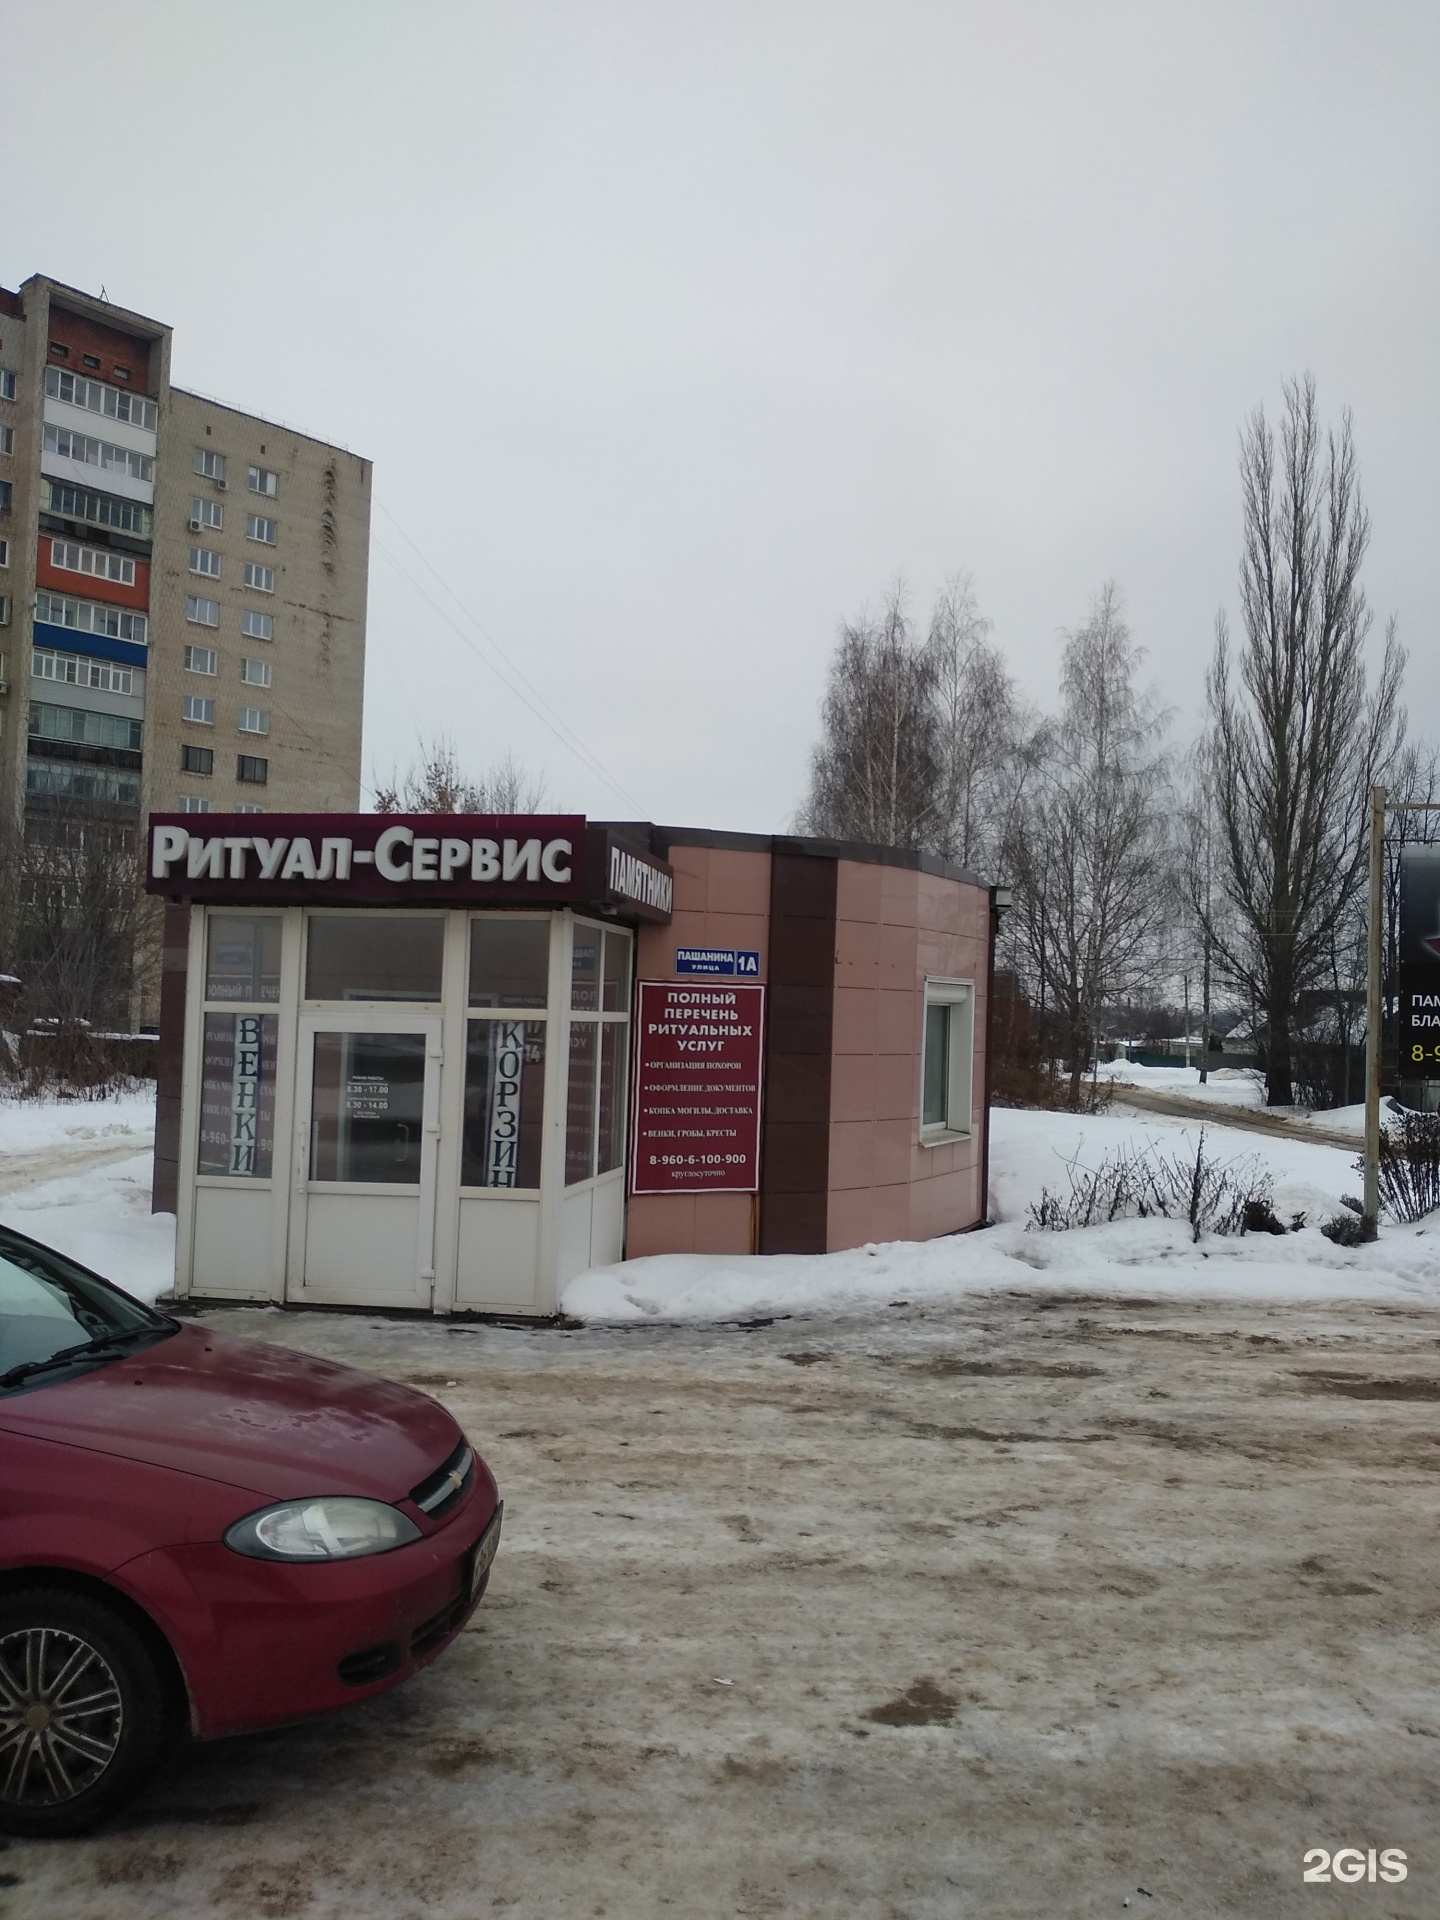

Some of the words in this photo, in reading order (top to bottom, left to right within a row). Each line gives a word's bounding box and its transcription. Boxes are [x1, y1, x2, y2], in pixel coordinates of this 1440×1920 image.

[152, 825, 573, 883] РИТУАЛ-СЕРВИС
[609, 846, 673, 914] ПАМЯТНИКИ
[677, 951, 734, 963] ПАШАНИНА
[738, 956, 757, 971] 1А
[667, 992, 736, 1005] ПОЛНЫЙ
[664, 1008, 739, 1020] ПЕРЕЧЕНЬ
[648, 1024, 752, 1036] РИТУАЛЬНЫХ
[677, 1040, 724, 1051] УСЛУГ
[650, 1062, 705, 1070] ОРГАНИЗАЦИЯ
[706, 1062, 742, 1070] ПОХОРОН
[705, 1084, 756, 1092] ДОКУМЕНТОВ
[232, 1018, 260, 1172] ВЕНКИ
[649, 1107, 676, 1115] КОПКА
[714, 1107, 753, 1115] ДОСТАВКА
[706, 1129, 737, 1137] КРЕСТЫ
[649, 1154, 747, 1165] 8-960-6-100-900
[671, 1170, 726, 1179] круглосуточно
